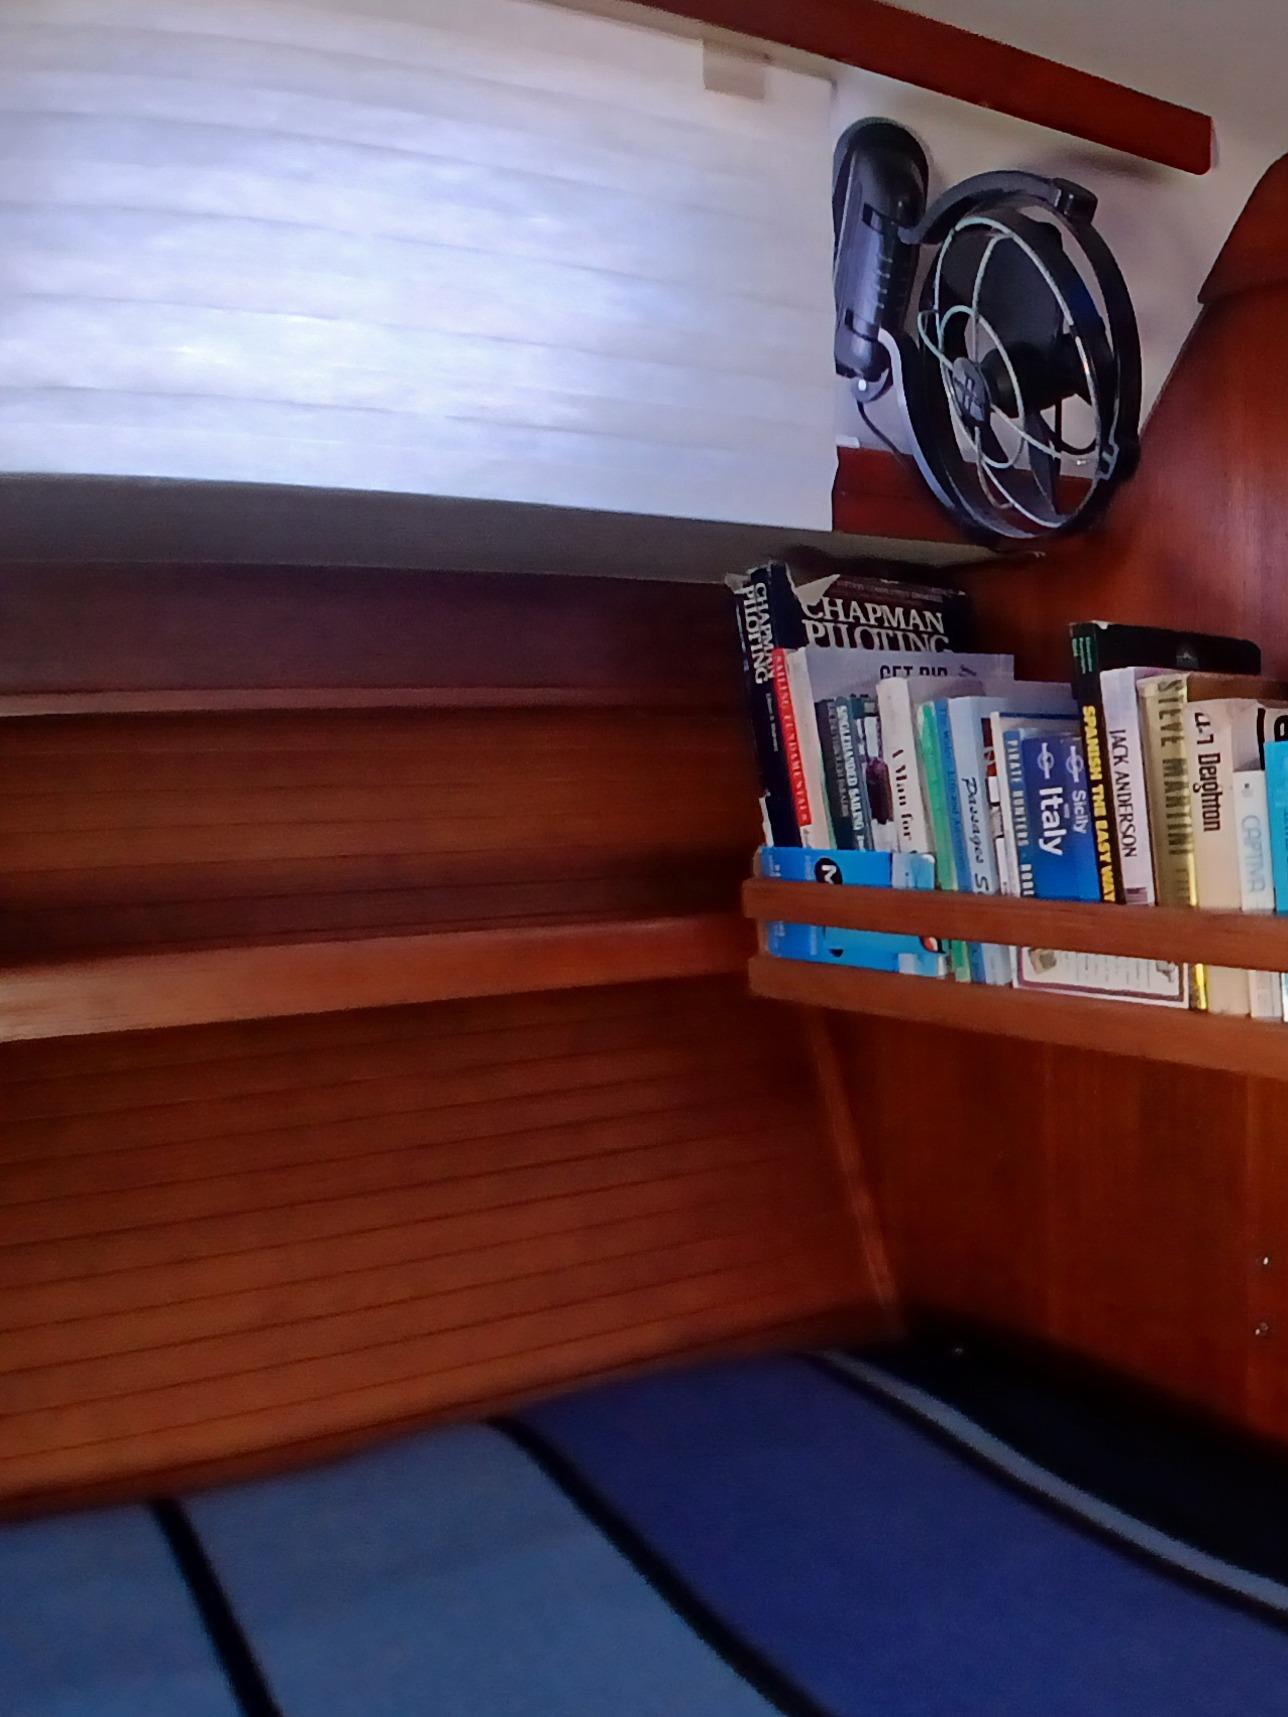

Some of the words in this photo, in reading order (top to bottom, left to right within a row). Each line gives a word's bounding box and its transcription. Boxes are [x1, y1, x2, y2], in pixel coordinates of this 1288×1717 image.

[743, 584, 769, 685] PILOTING
[753, 582, 776, 678] CHAPMAN
[801, 596, 945, 635] CHAPMAN
[802, 618, 952, 654] PILOTING
[1081, 705, 1103, 781] SPANISH
[1158, 679, 1186, 748] STEVE
[1008, 739, 1023, 785] PIRATE
[1109, 728, 1129, 766] JACK
[962, 776, 986, 864] Passages
[1012, 789, 1030, 847] HUNTERS
[1038, 786, 1067, 856] Italy
[1071, 789, 1089, 834] Sicily
[1090, 784, 1107, 818] THE
[1114, 770, 1137, 858] ANDERSON
[1162, 757, 1189, 857] MARTINI
[1095, 821, 1111, 863] EASY
[1241, 814, 1266, 893] CAPTIVA
[1100, 865, 1116, 904] WAY
